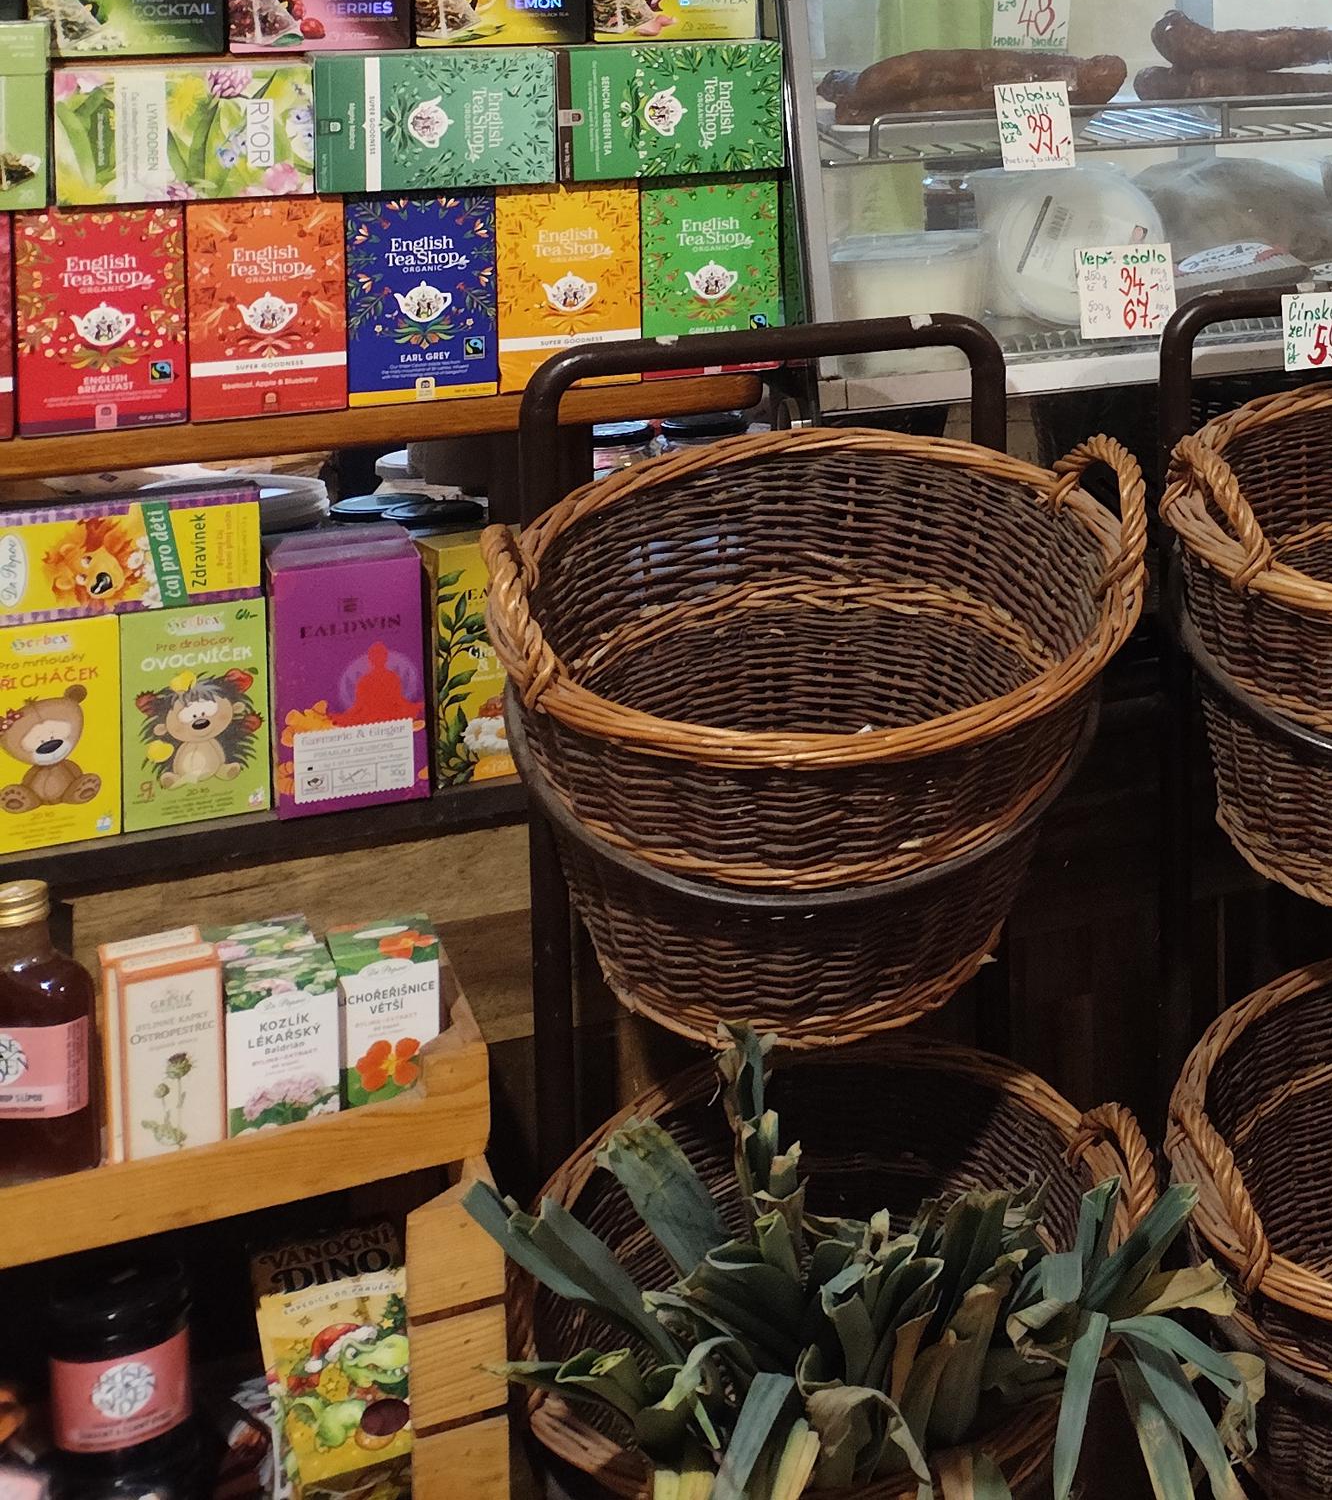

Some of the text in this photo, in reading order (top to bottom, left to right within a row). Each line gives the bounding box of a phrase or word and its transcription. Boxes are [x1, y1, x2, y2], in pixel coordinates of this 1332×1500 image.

[131, 3, 216, 17] COCKTAIL
[325, 1, 393, 15] BERRIES
[998, 87, 1064, 106] Klobásy
[1014, 104, 1049, 118] chilli
[681, 217, 740, 236] English
[538, 227, 599, 246] English
[232, 245, 299, 265] English
[390, 236, 454, 257] English
[66, 254, 137, 274] English
[402, 264, 443, 274] ORGANIC
[79, 285, 126, 295] ORGANIC
[400, 351, 451, 363] EARL GREY
[78, 381, 133, 394] BREAKFAST
[83, 374, 128, 386] ENGLISH
[157, 543, 177, 571] pro
[192, 513, 207, 588] Zdravínek
[141, 646, 253, 672] OVOCNÍČEK
[369, 997, 404, 1015] VĚTŠÍ
[259, 1013, 310, 1033] KOZLÍK
[247, 1024, 321, 1049] LÉKAŘSKÝ
[270, 1248, 392, 1294] DINO
